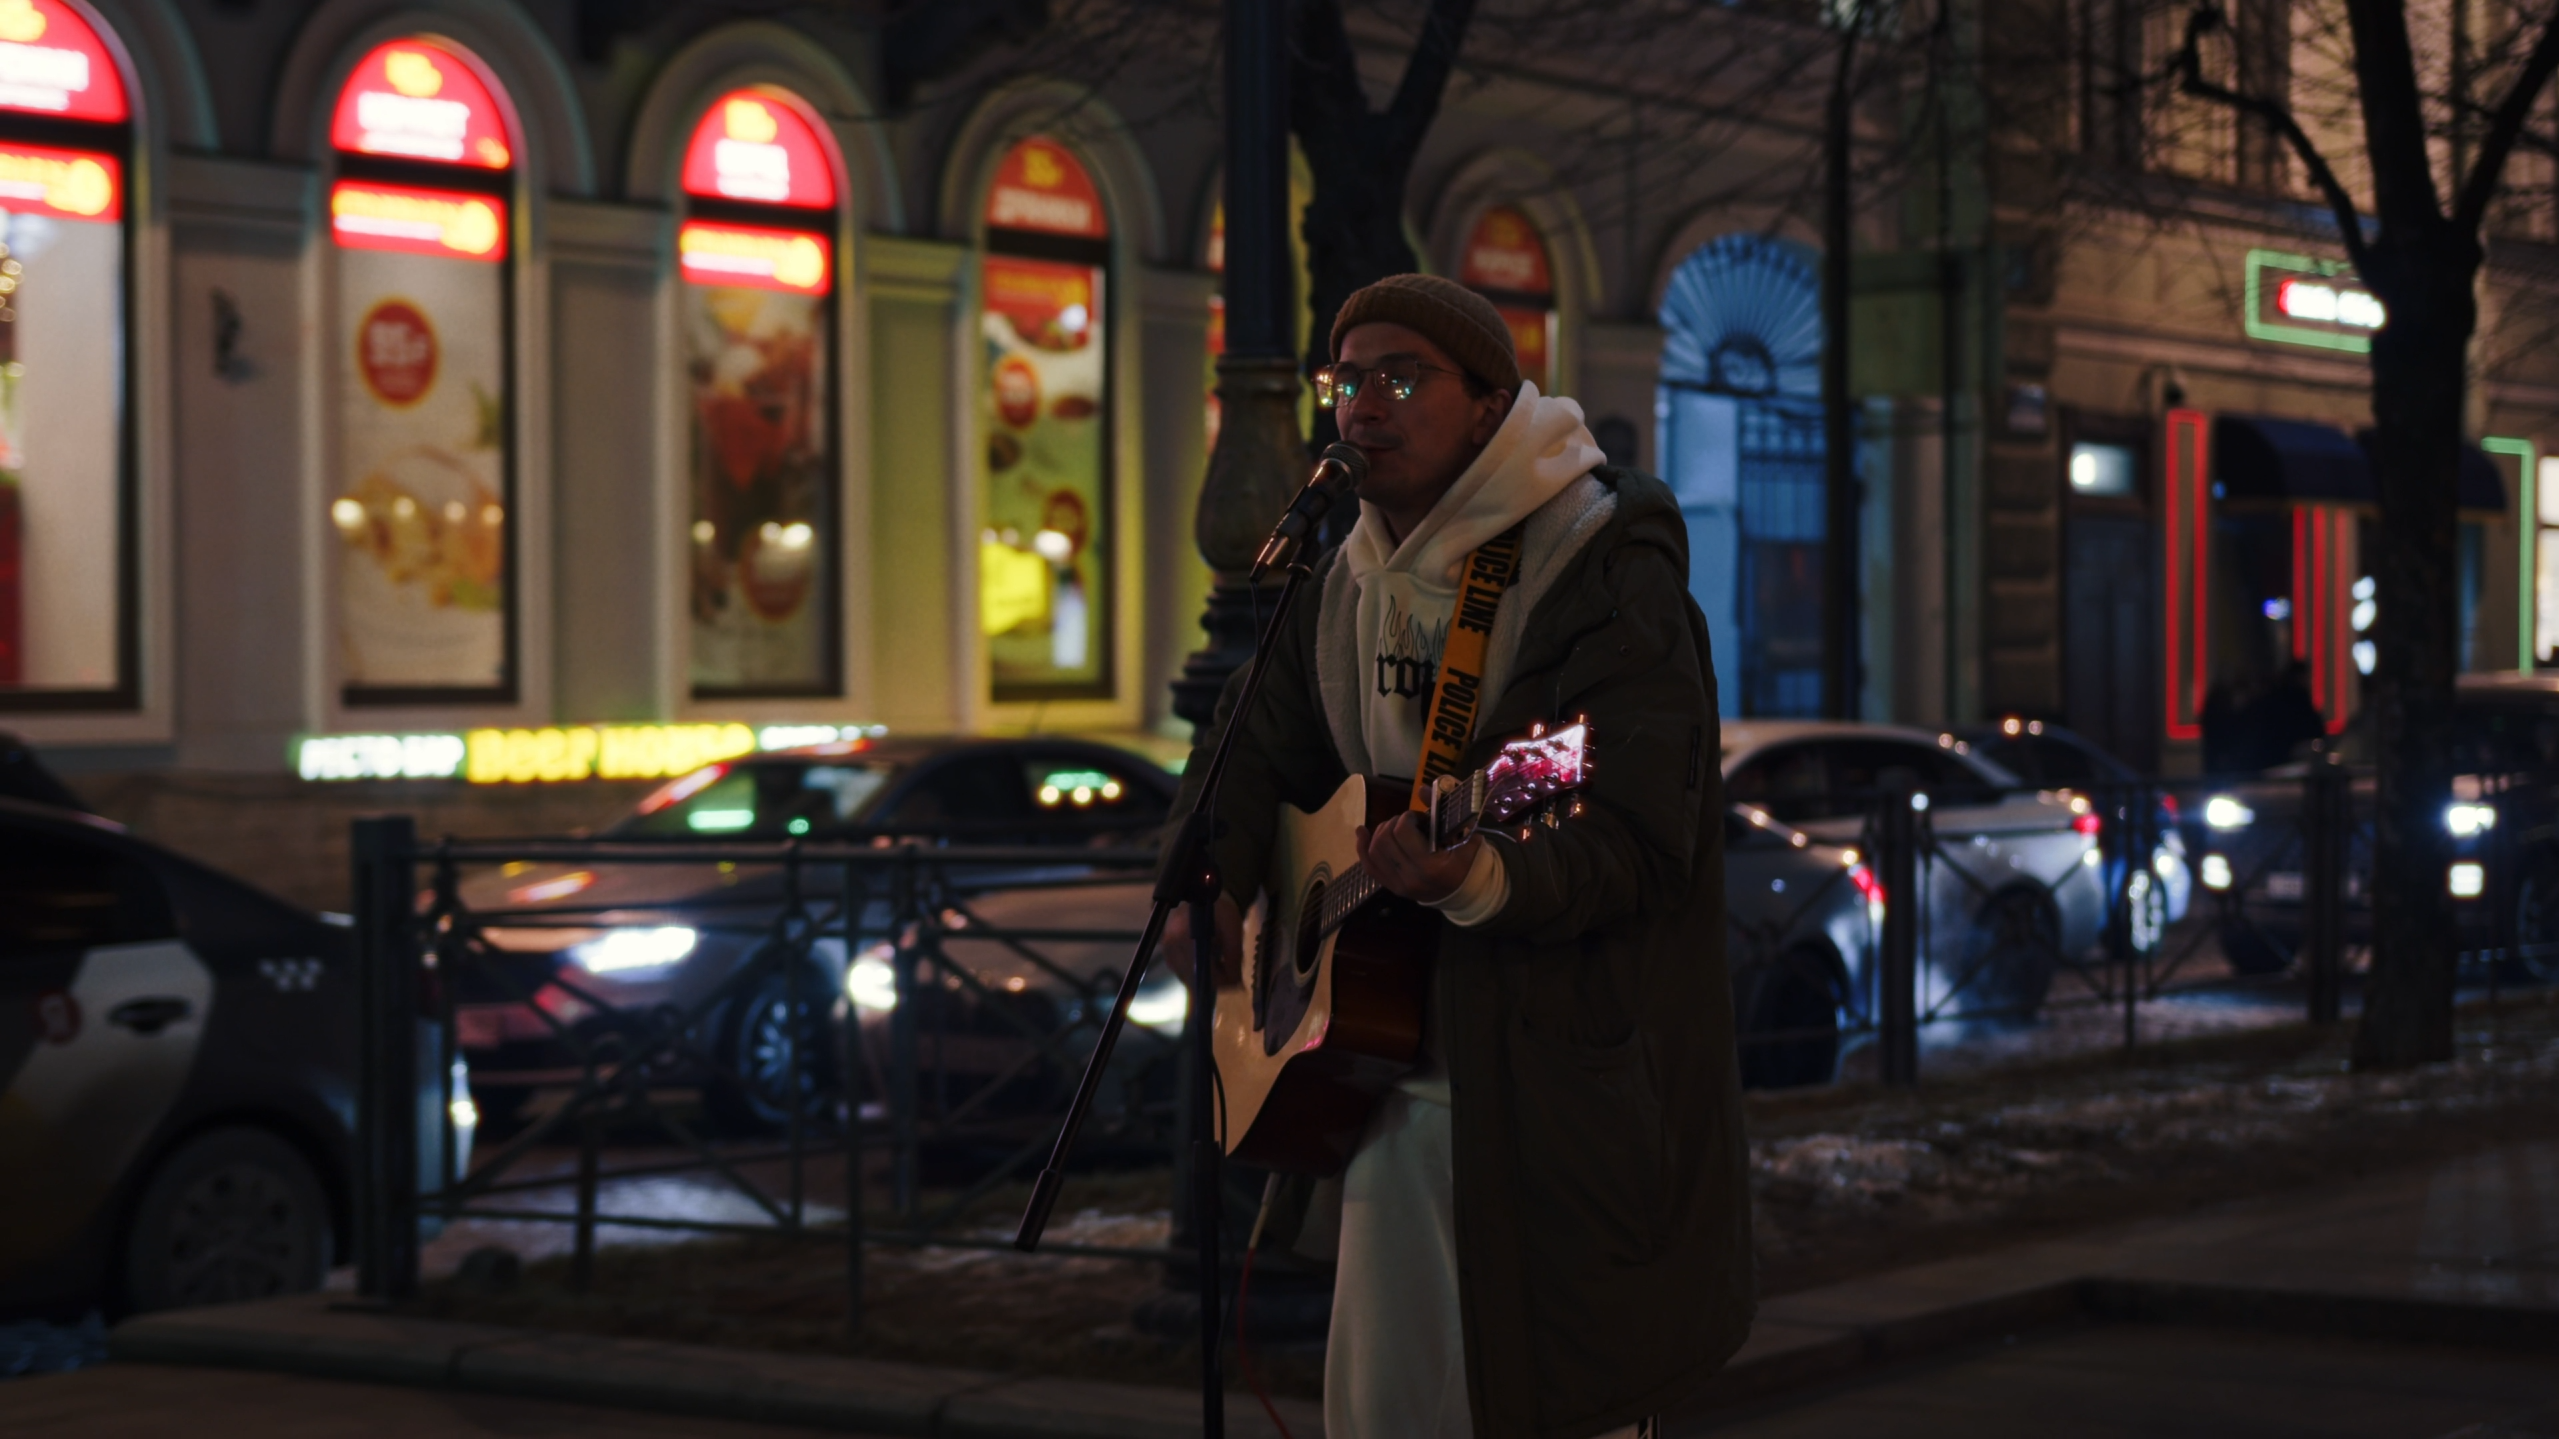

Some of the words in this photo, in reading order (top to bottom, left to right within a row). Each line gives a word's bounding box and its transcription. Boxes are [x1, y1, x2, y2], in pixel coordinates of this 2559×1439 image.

[1469, 526, 1518, 587] OLICE
[1458, 584, 1503, 637] LINE
[1431, 666, 1480, 751] POLICE
